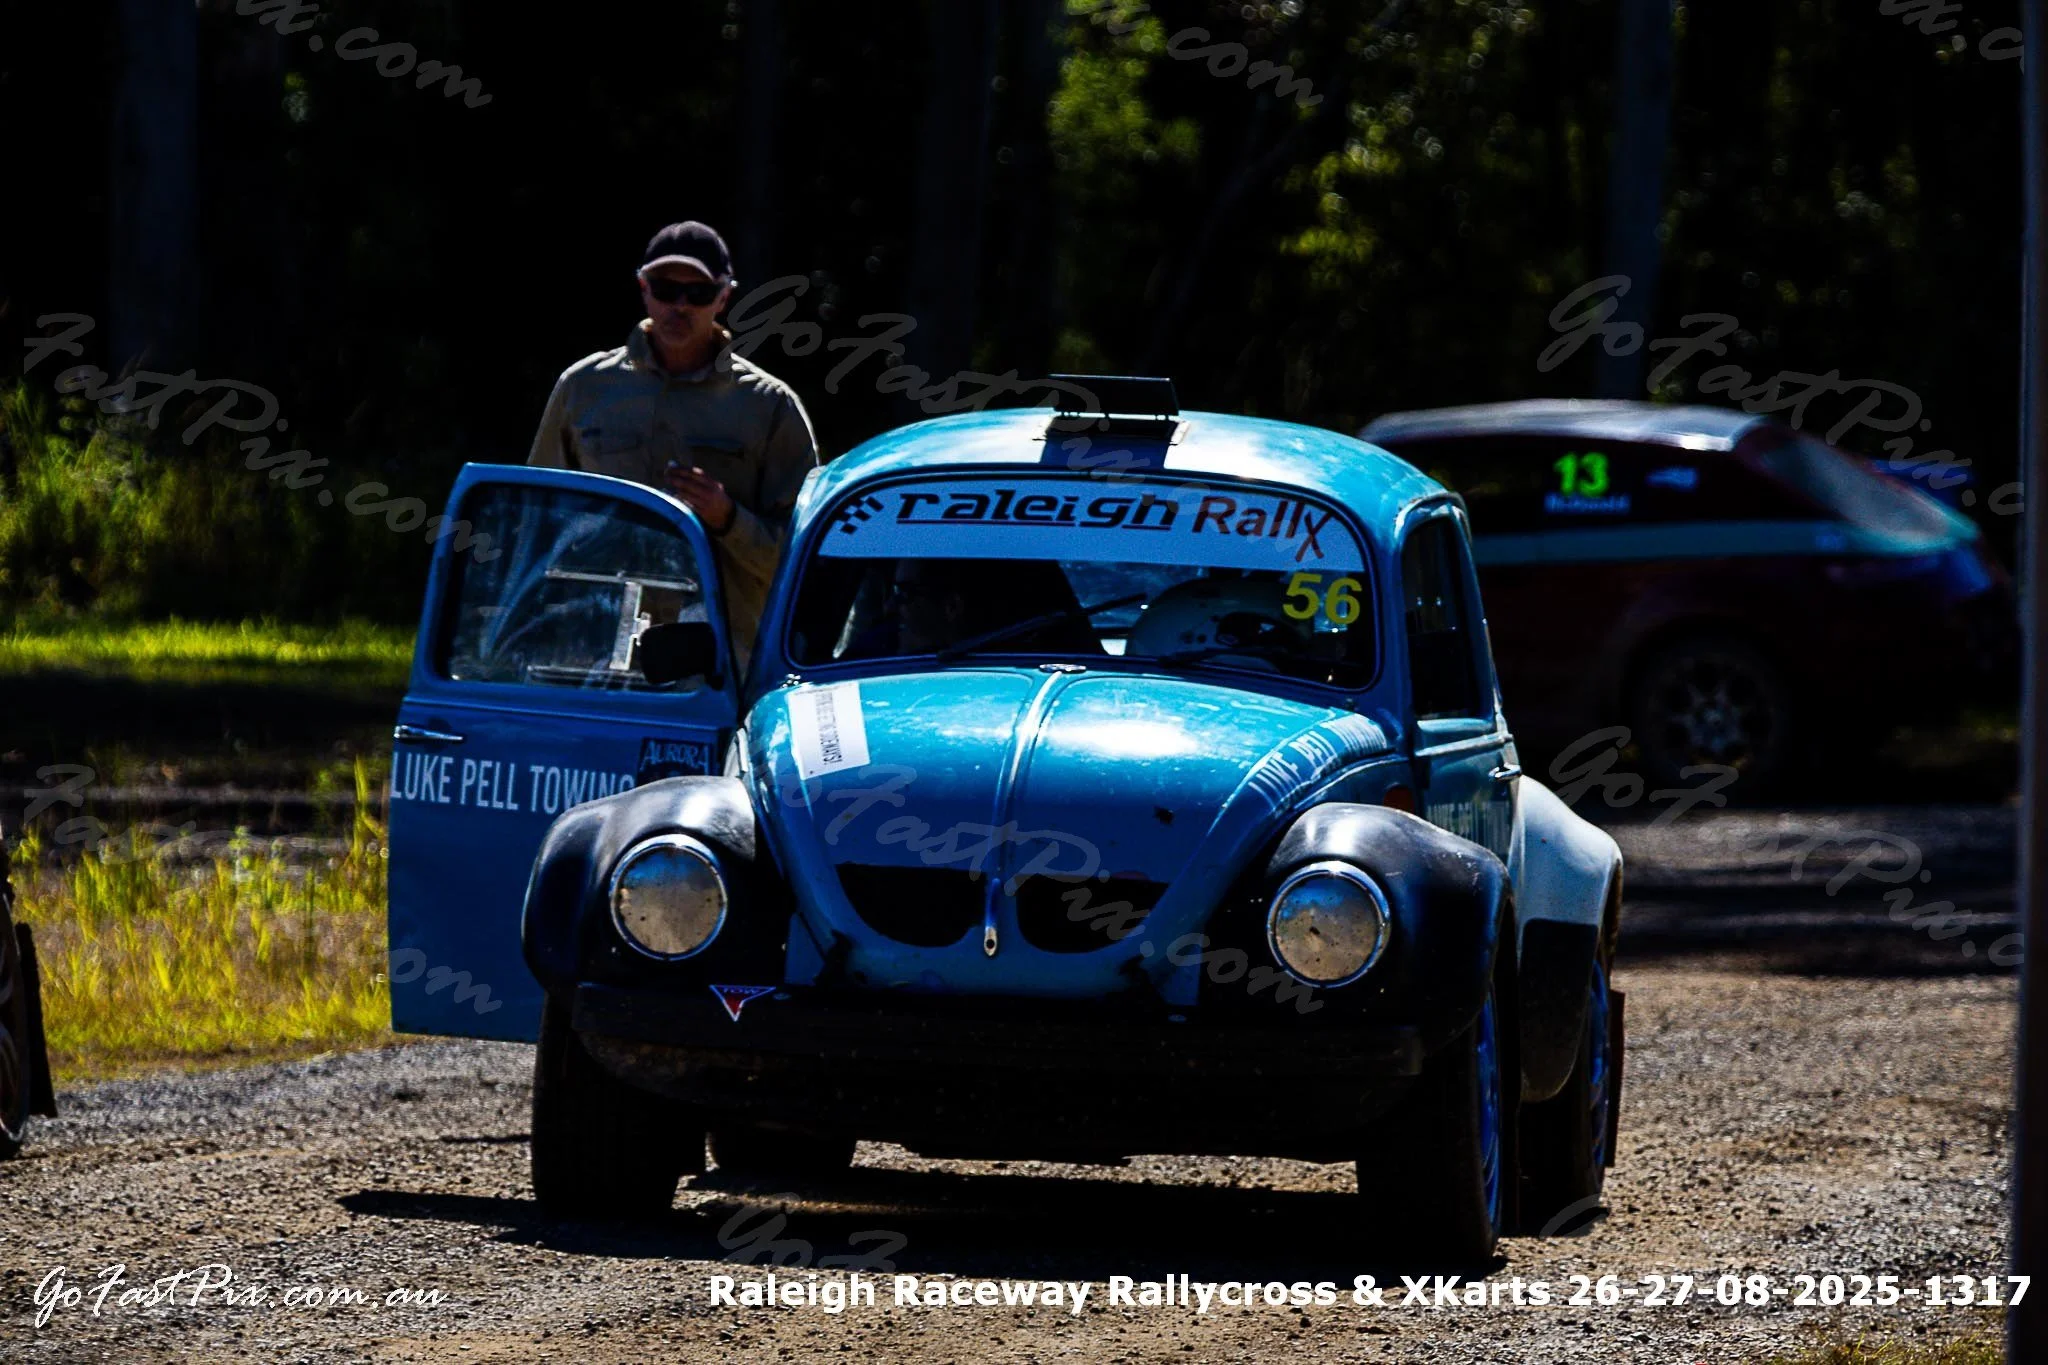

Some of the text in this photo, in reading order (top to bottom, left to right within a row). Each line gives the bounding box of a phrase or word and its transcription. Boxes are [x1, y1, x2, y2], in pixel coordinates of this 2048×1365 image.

[1552, 451, 1611, 498] 13
[897, 489, 1177, 528] raleigh
[1282, 573, 1363, 626] 56
[390, 751, 454, 804] LUKE
[460, 758, 519, 811] PELL
